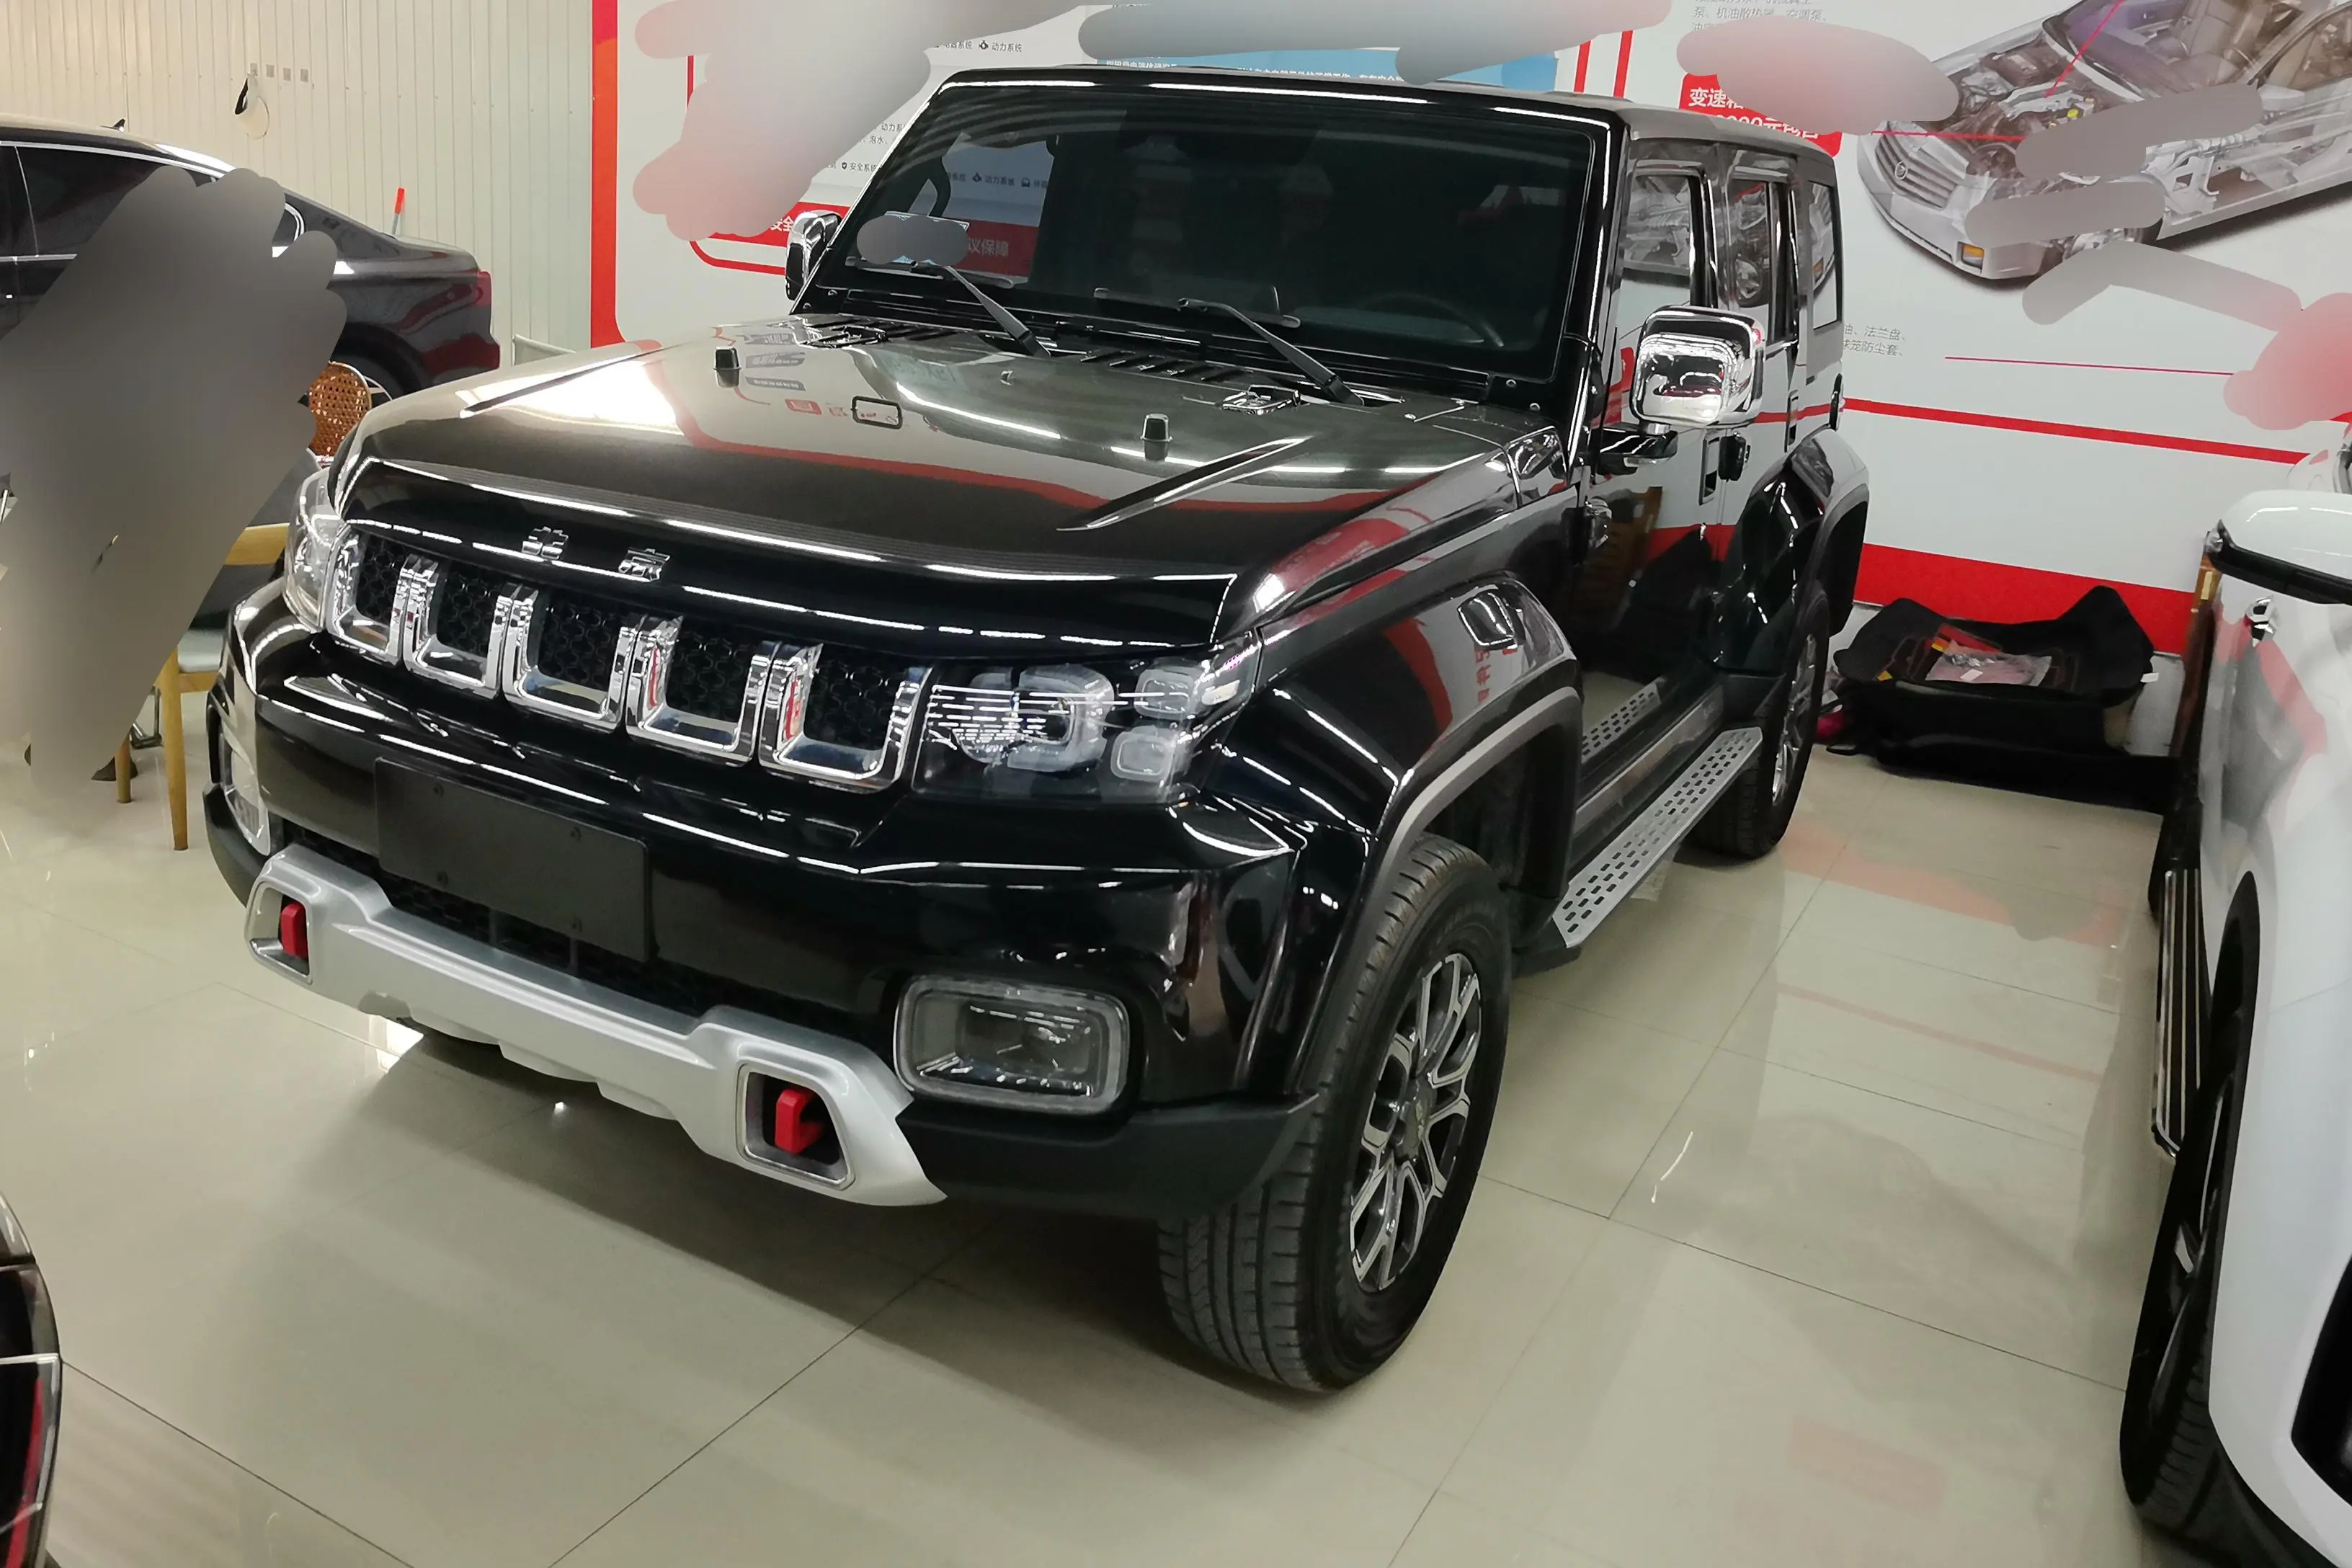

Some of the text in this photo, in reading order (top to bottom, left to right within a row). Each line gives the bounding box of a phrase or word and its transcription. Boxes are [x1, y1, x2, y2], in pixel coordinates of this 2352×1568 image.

[992, 42, 1022, 52] 动力系统
[881, 122, 906, 133] 动力系
